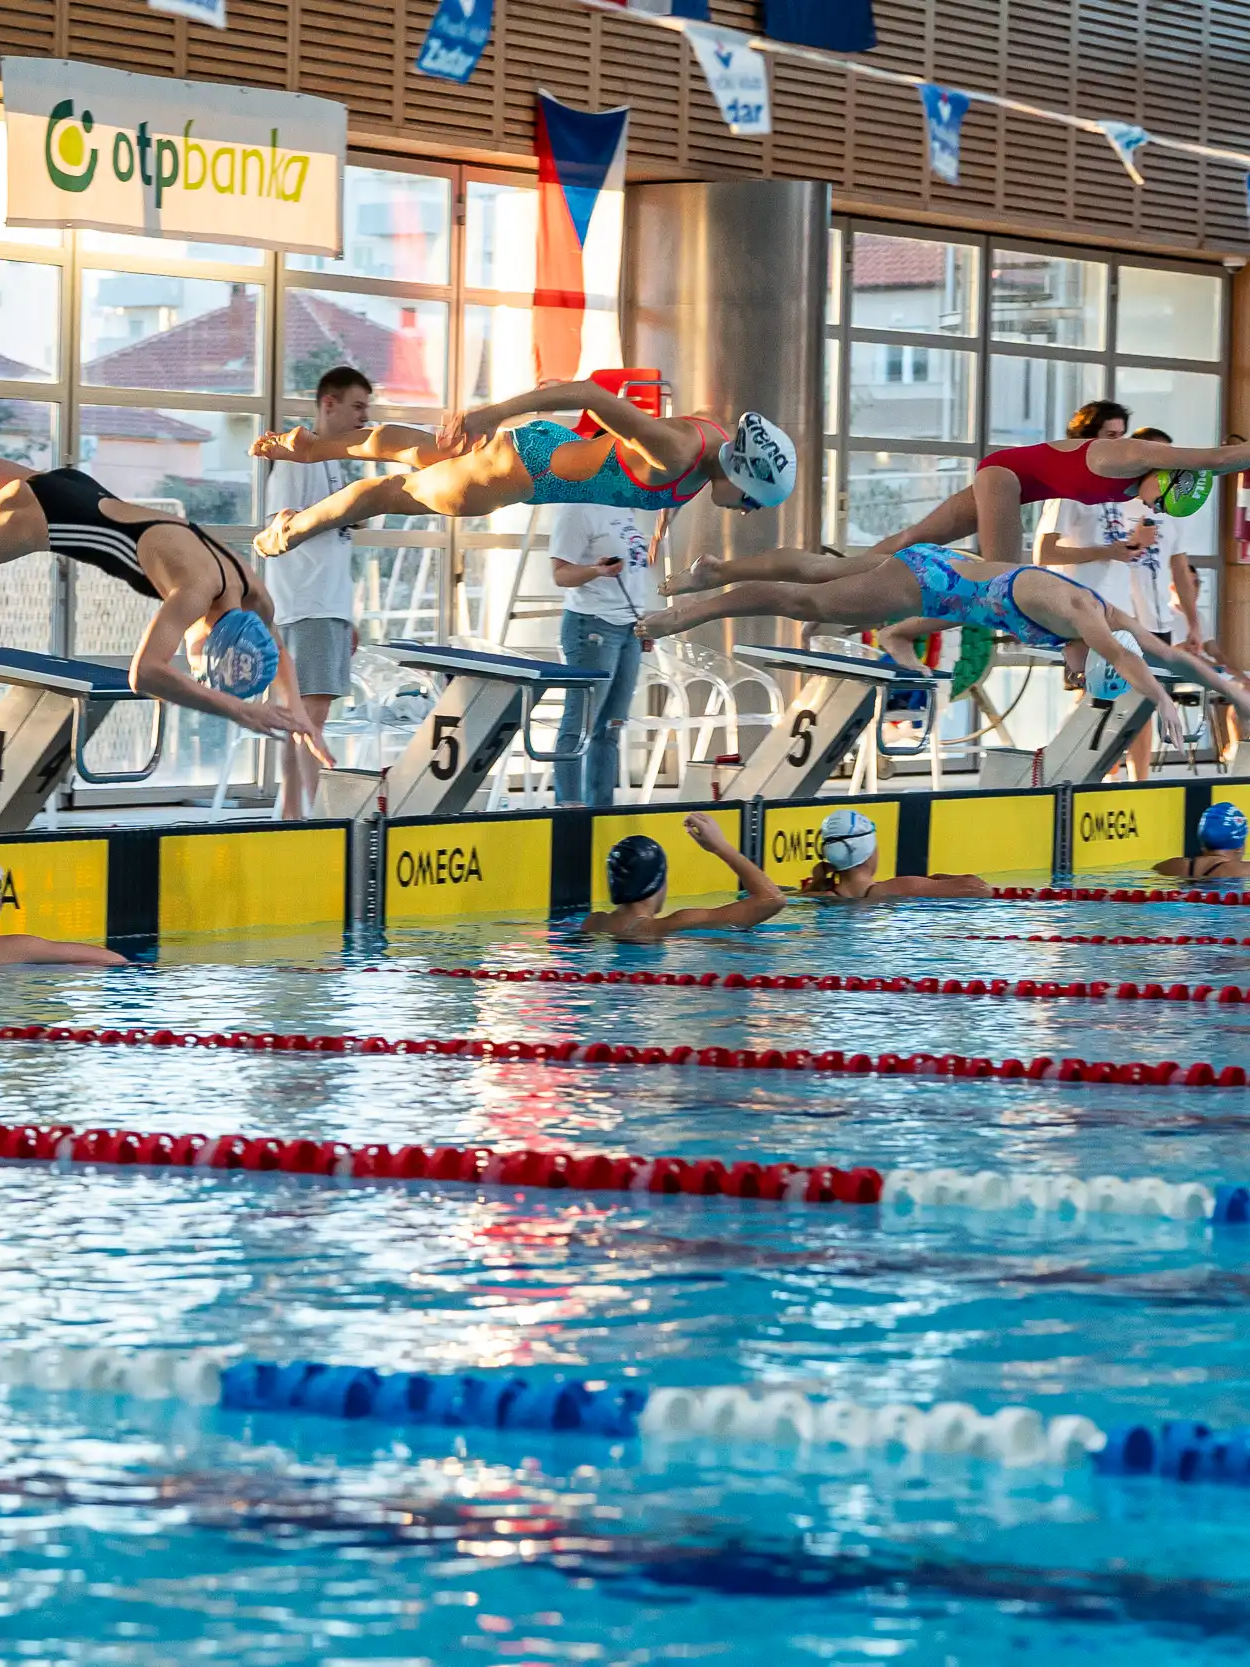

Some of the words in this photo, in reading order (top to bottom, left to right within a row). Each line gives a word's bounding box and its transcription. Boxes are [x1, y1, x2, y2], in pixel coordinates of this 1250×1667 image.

[745, 412, 789, 474] arena
[431, 715, 461, 781] 5
[1089, 698, 1116, 752] 7
[772, 828, 823, 864] OME
[1080, 808, 1140, 843] OMEGA
[396, 846, 484, 888] OMEGA
